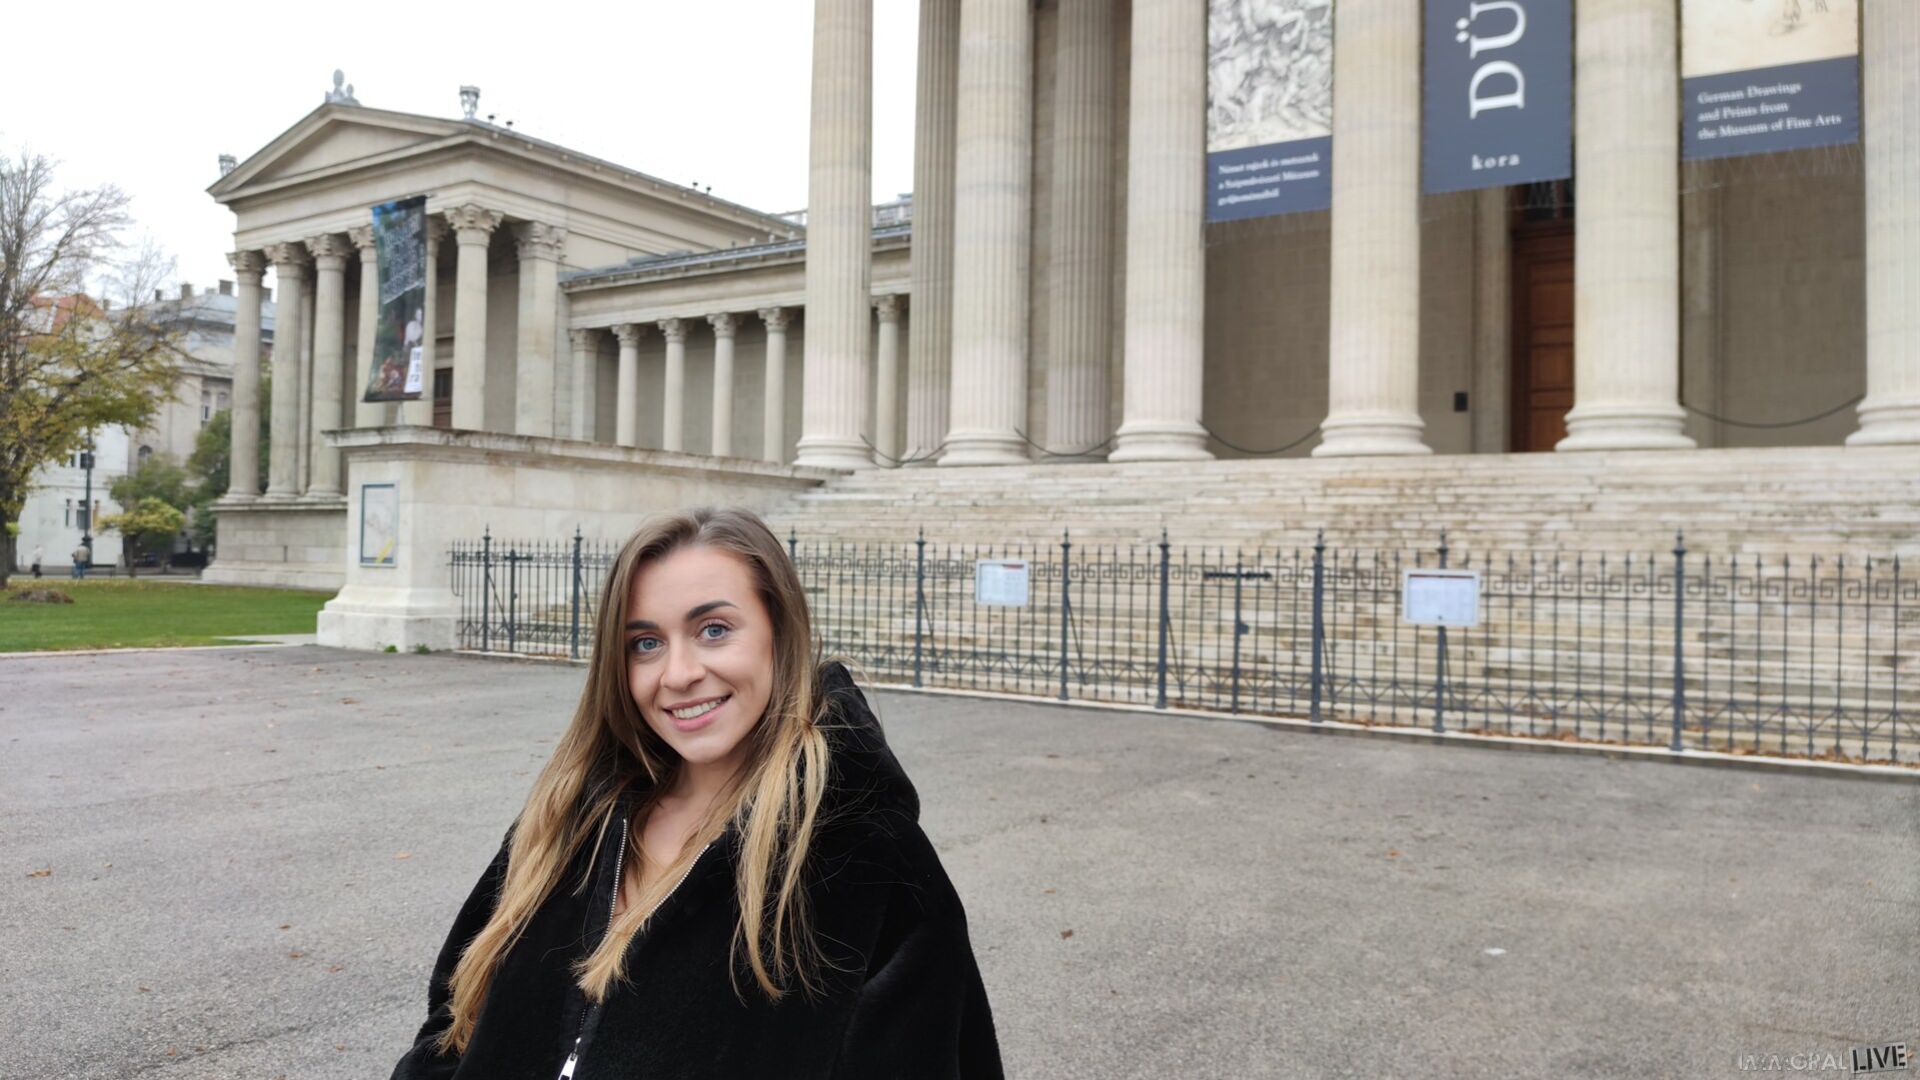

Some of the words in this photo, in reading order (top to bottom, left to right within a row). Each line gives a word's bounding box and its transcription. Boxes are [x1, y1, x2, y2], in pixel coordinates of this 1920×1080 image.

[1455, 0, 1526, 120] DÜ
[1697, 91, 1744, 104] German
[1747, 82, 1802, 98] Drawings
[1697, 109, 1720, 122] and
[1722, 106, 1758, 120] Prints
[1760, 102, 1789, 114] from
[1697, 128, 1717, 140] the
[1719, 123, 1768, 137] Museum
[1771, 120, 1783, 131] of
[1786, 116, 1812, 130] Fine
[1815, 113, 1842, 126] Arts
[1471, 154, 1520, 170] kora
